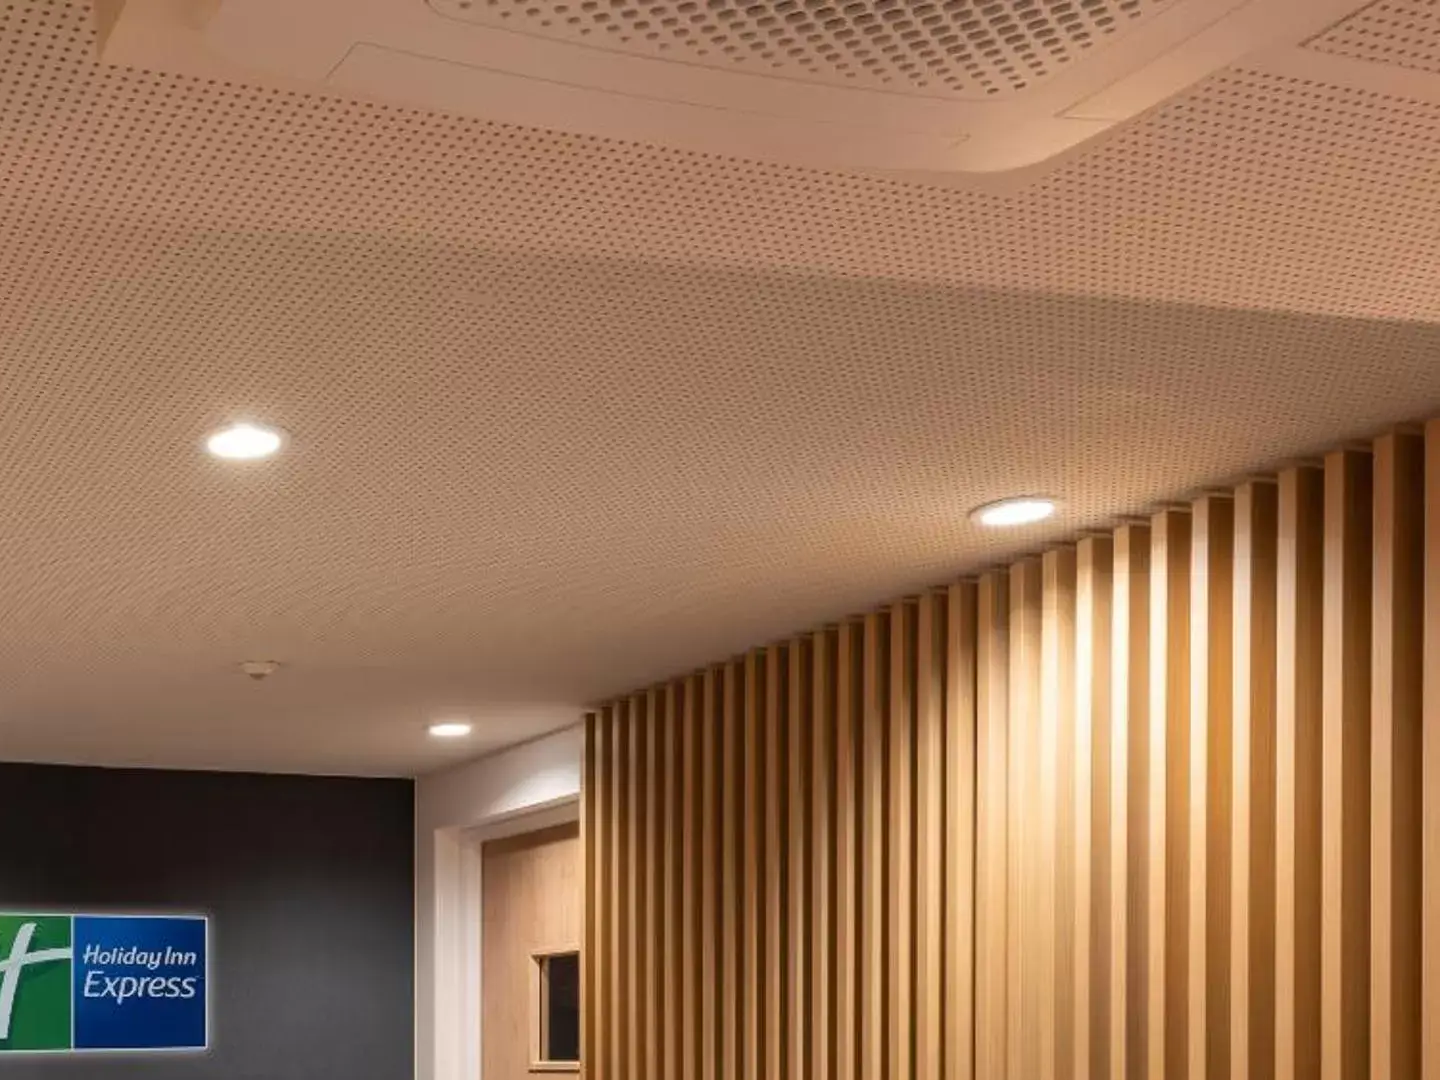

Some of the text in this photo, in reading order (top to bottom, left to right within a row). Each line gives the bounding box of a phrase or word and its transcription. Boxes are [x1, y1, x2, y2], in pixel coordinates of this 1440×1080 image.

[83, 943, 197, 971] Holiday Inn
[83, 970, 197, 1005] Express
